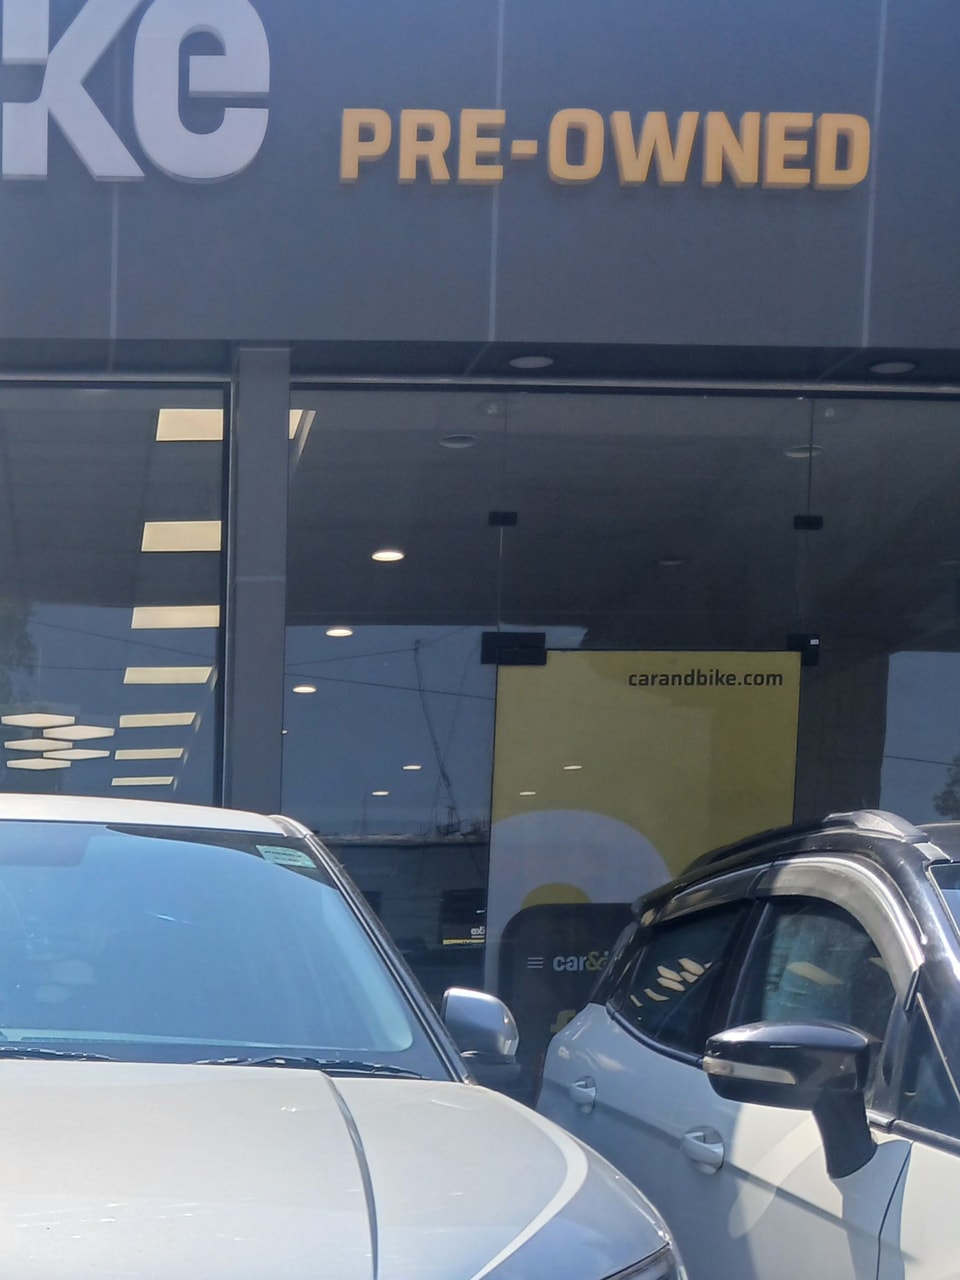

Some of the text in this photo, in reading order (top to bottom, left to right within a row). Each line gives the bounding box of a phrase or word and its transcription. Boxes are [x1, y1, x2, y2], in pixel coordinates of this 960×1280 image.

[339, 108, 871, 190] PRE-OWNED
[628, 669, 783, 687] carandbike.com
[553, 951, 609, 973] car&
